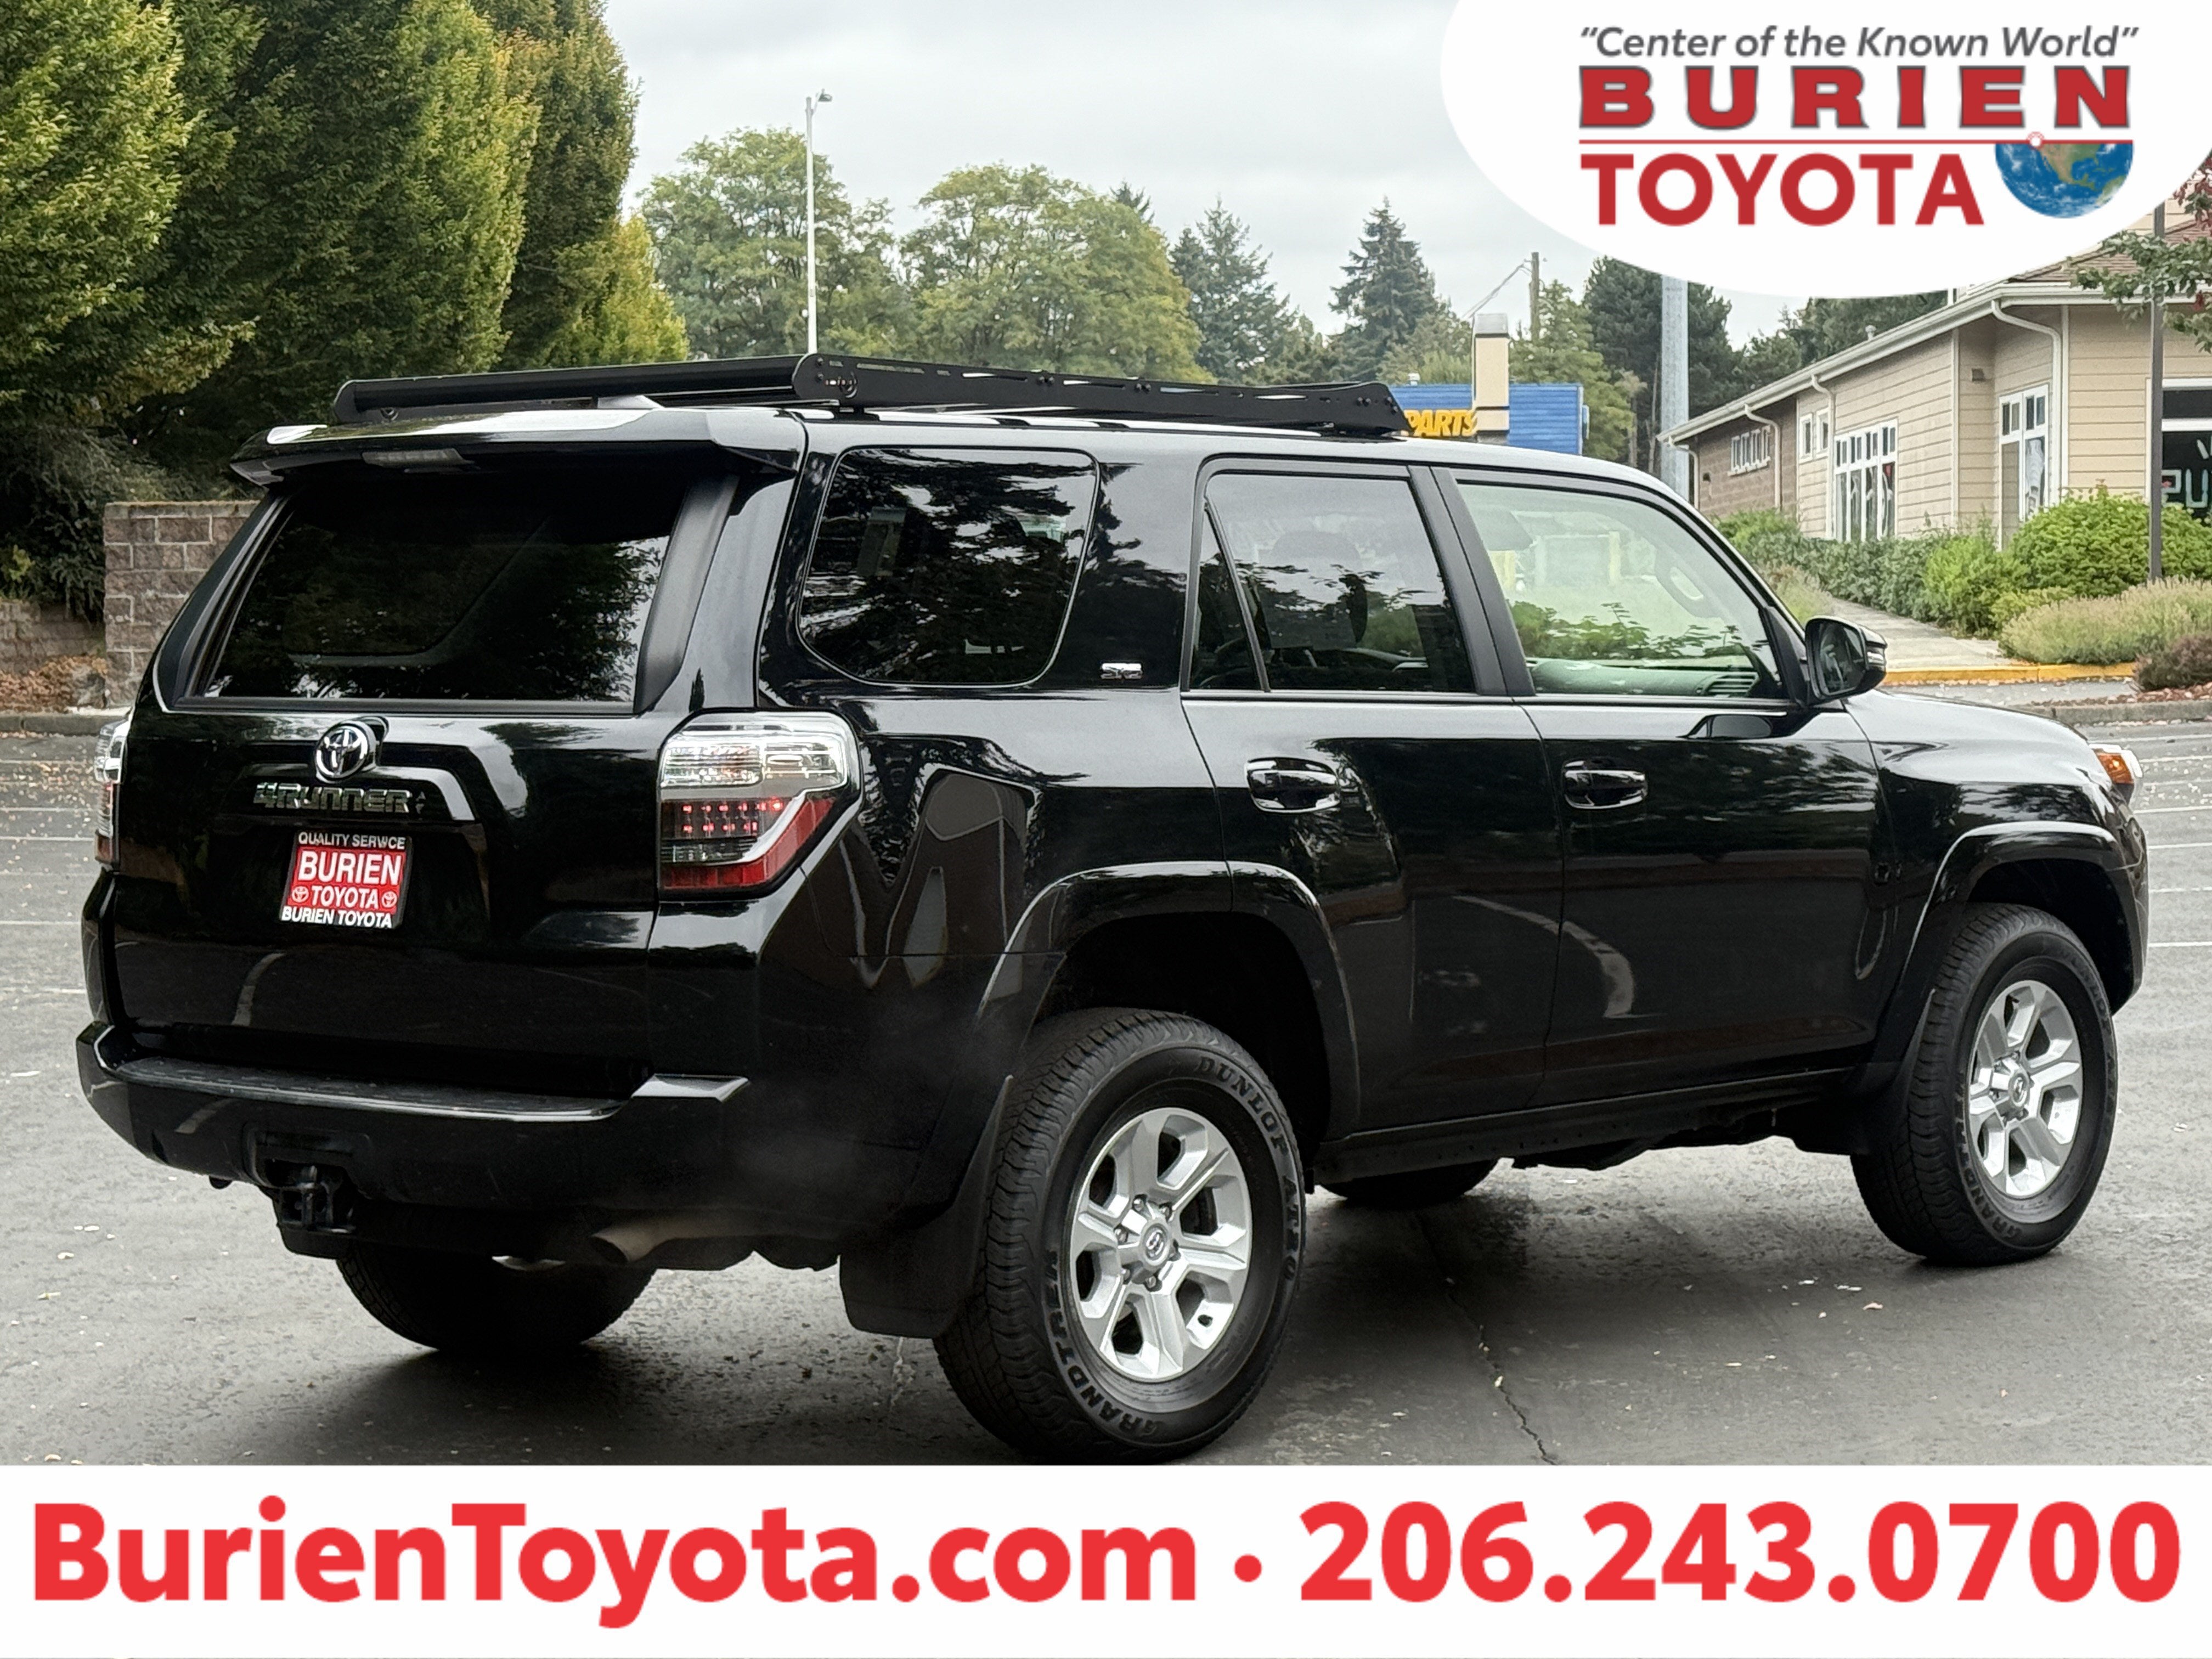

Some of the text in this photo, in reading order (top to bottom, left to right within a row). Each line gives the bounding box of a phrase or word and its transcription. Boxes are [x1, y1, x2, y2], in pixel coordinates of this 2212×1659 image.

[1405, 409, 1477, 437] PARTS
[298, 831, 406, 850] QUALITY SERVICE
[297, 850, 402, 885] BURIEN
[311, 885, 379, 909] TOYOTA
[281, 906, 393, 929] BURIEN TOYOTA
[1195, 1055, 1289, 1158] DUNLOP
